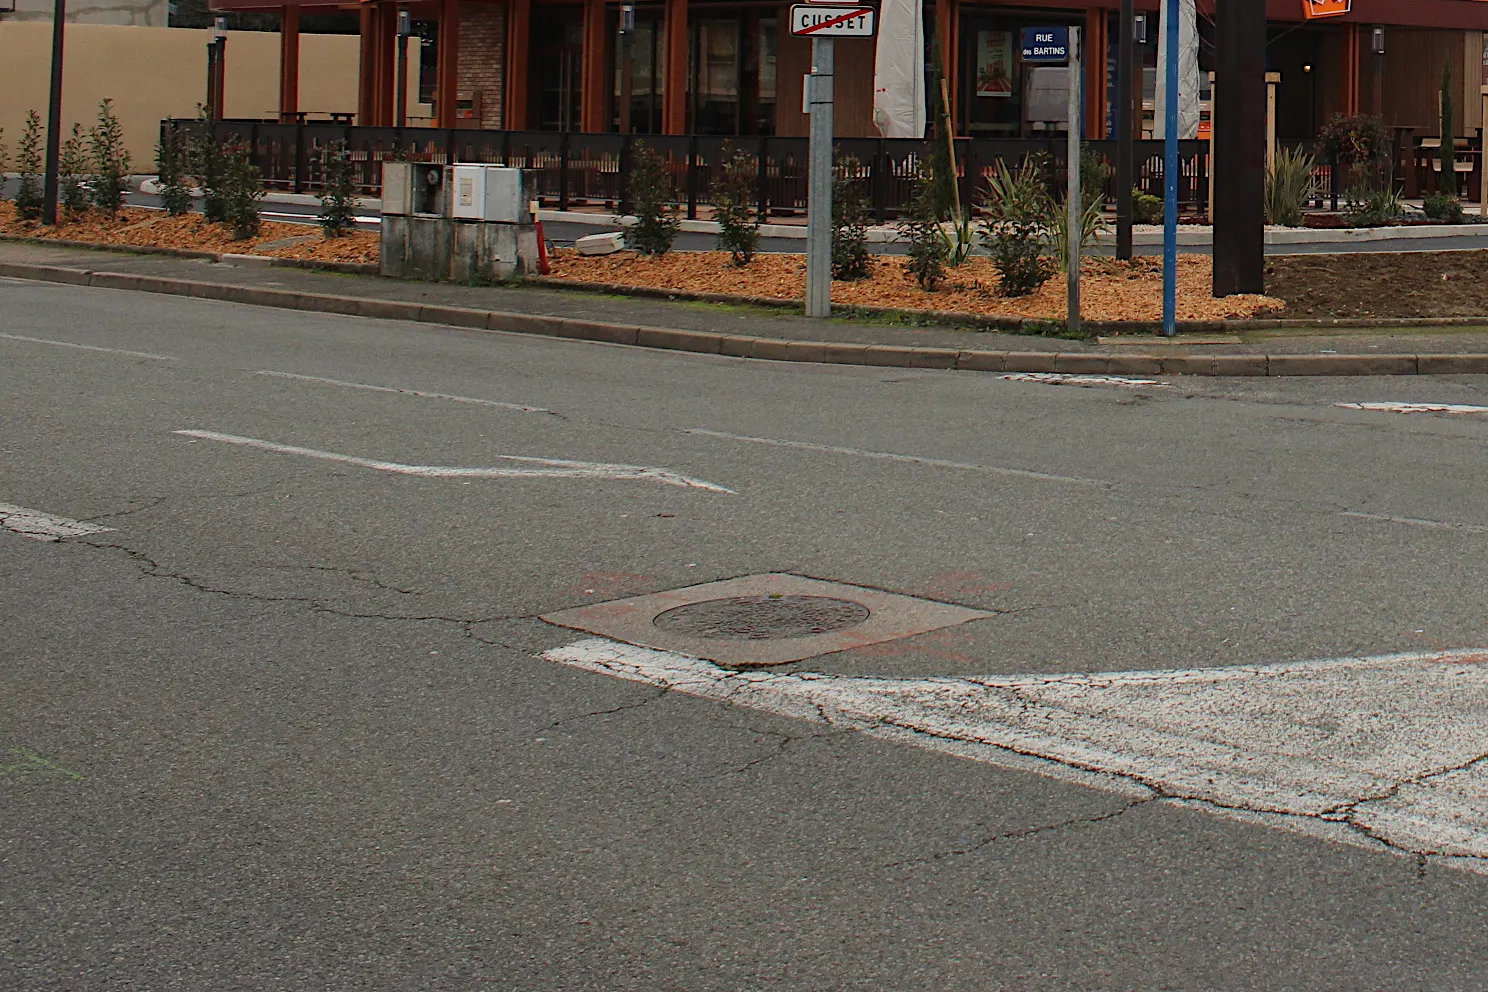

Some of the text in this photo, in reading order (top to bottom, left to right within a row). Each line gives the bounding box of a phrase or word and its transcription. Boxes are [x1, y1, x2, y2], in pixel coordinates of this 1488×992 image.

[801, 14, 866, 30] CUSSET
[1035, 33, 1053, 42] RUE
[1033, 47, 1065, 55] BARTINS
